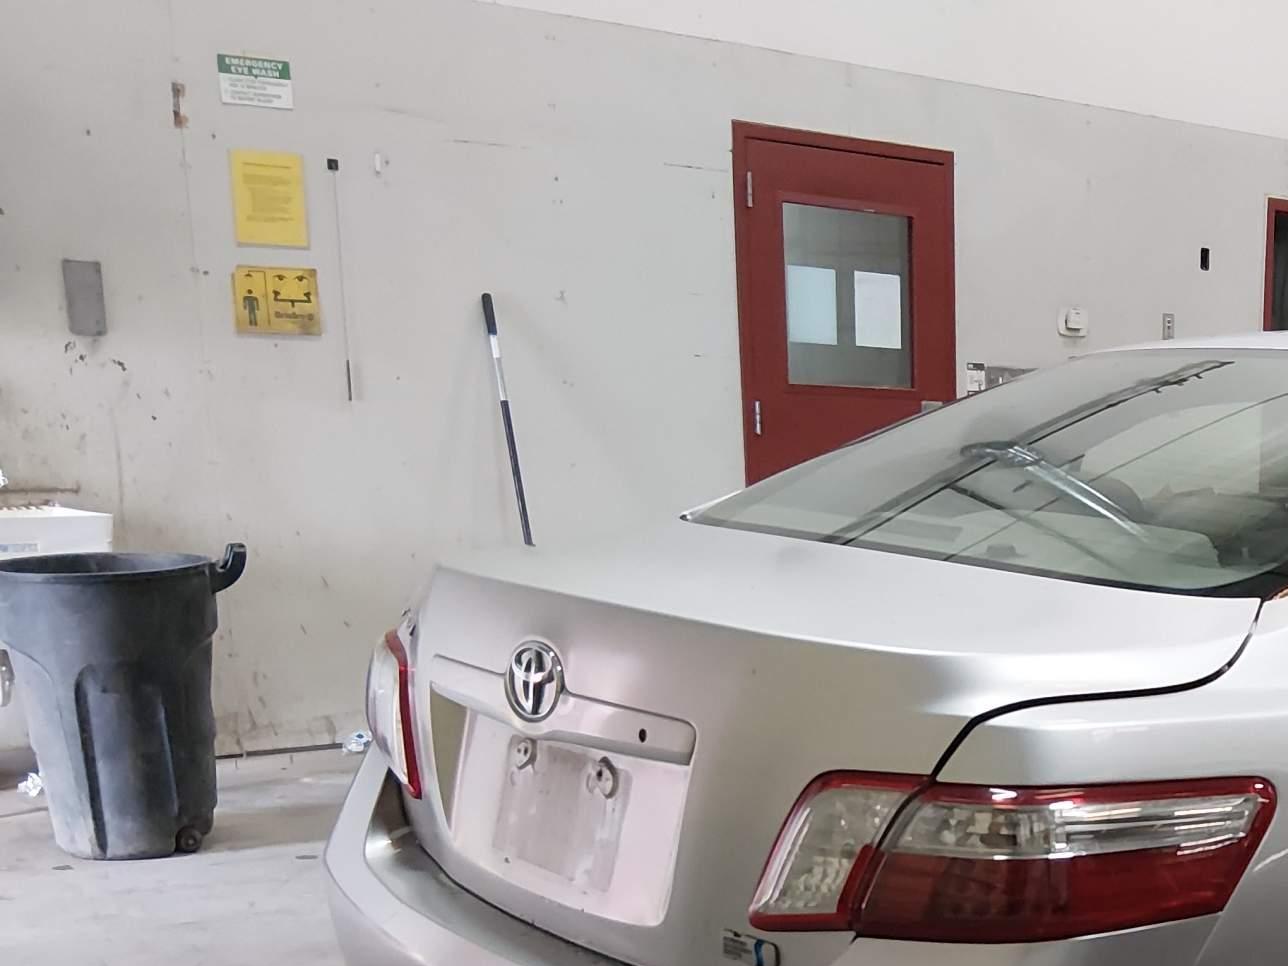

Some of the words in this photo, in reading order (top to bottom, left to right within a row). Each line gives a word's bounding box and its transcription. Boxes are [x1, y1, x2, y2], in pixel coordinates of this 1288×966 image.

[225, 56, 283, 70] EMERGENCY
[230, 65, 249, 75] EYE
[251, 68, 280, 78] WASH
